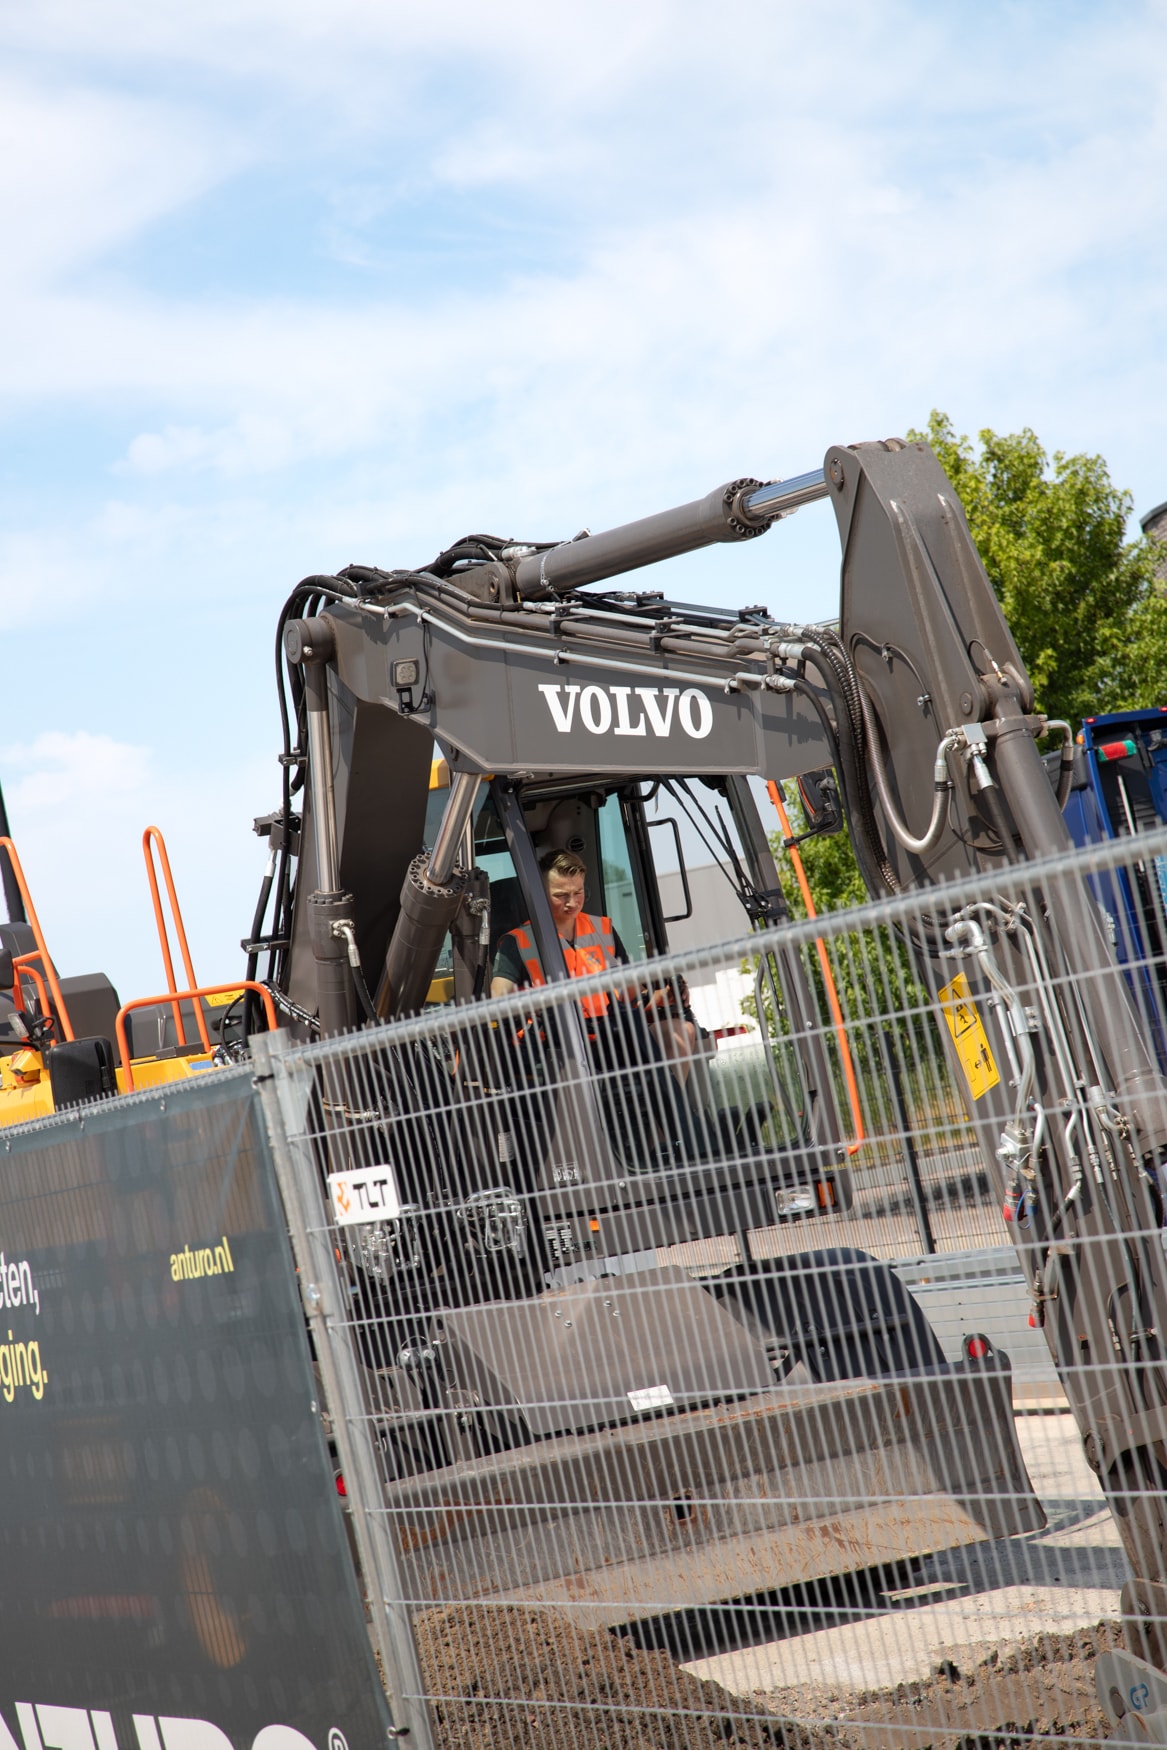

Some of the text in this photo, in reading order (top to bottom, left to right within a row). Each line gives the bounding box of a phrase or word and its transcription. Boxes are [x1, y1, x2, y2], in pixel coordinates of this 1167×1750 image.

[538, 684, 713, 739] VOLVO
[353, 1179, 388, 1210] TLT
[0, 1252, 40, 1315] ten,
[170, 1236, 234, 1282] anturo.nl
[0, 1329, 48, 1403] ging.
